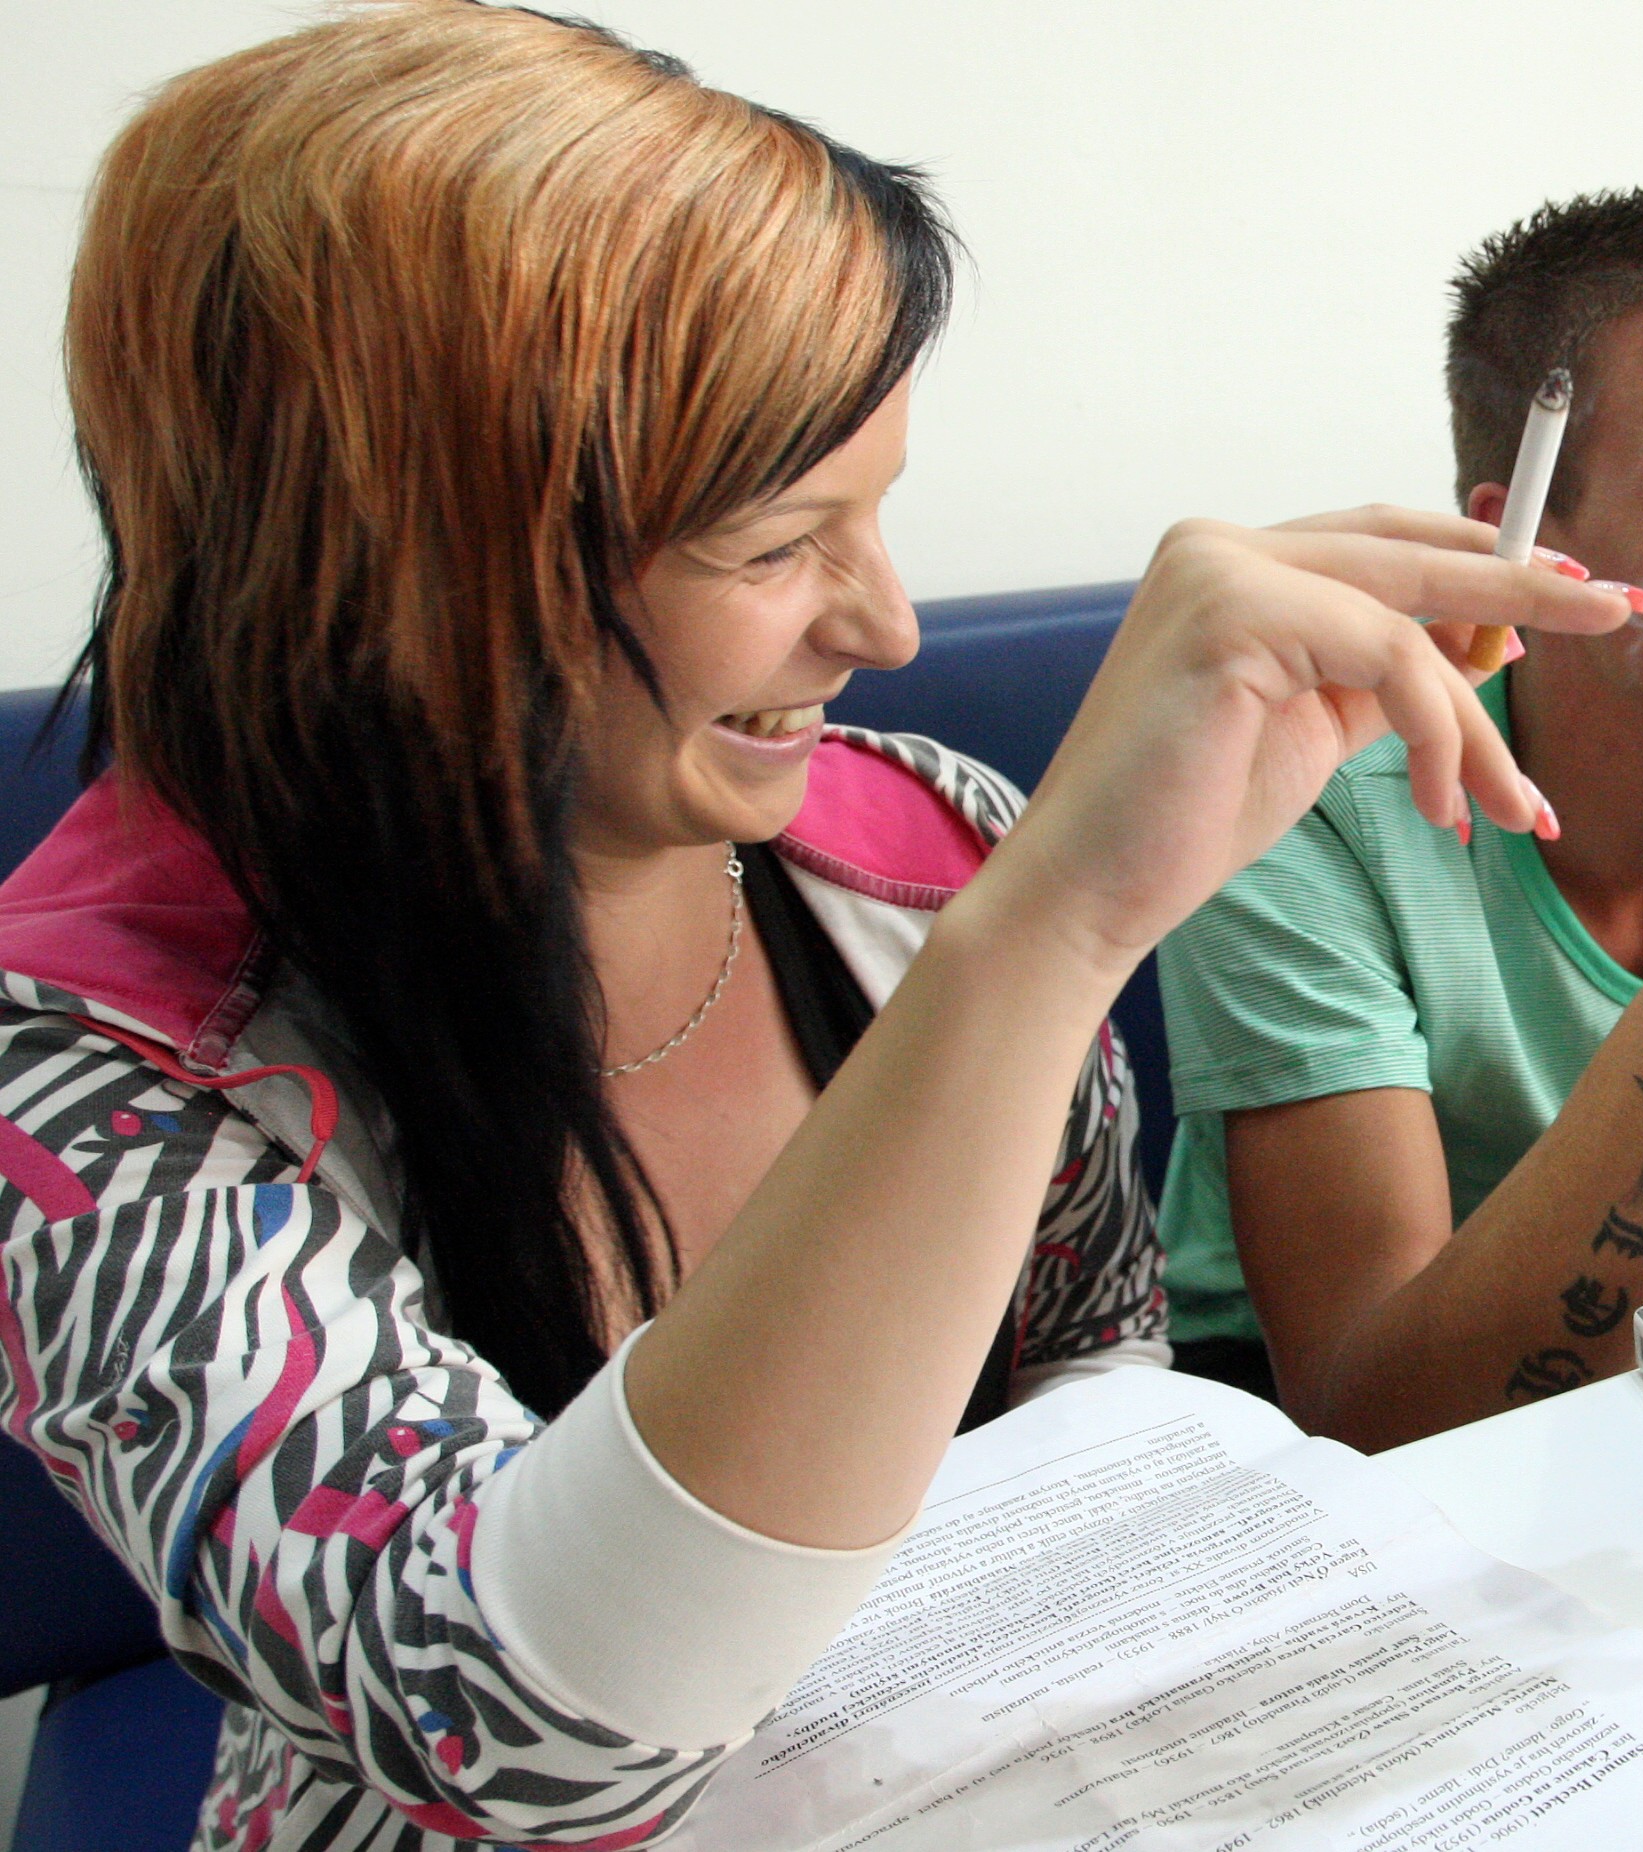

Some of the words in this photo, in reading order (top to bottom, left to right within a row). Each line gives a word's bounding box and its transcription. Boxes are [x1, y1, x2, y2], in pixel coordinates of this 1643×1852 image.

[1266, 1536, 1310, 1560] Smútok
[1290, 1543, 1322, 1559] Cesta
[1339, 1539, 1359, 1549] hra
[1294, 1552, 1332, 1571] Veľký
[1329, 1548, 1368, 1567] Eugen
[1218, 1558, 1264, 1581] pristane
[1250, 1559, 1288, 1580] dlhého
[1268, 1571, 1292, 1583] boh
[1347, 1562, 1377, 1578] USA
[1175, 1579, 1219, 1598] Elektre
[1209, 1589, 1224, 1597] do
[1223, 1584, 1266, 1604] Brown
[1225, 1580, 1247, 1590] dňa
[1180, 1595, 1206, 1607] noci
[1340, 1595, 1370, 1610] Dom
[1387, 1592, 1407, 1603] hry
[1108, 1601, 1160, 1626] moderná
[1171, 1606, 1210, 1623] dráma
[1285, 1609, 1338, 1634] Bernardy
[1331, 1606, 1378, 1628] Krvavá
[1364, 1601, 1417, 1624] Federico
[1364, 1607, 1428, 1636] Španielsko
[1067, 1625, 1106, 1642] verzia
[1168, 1623, 1199, 1639] 1888
[1285, 1626, 1329, 1645] svadba
[1318, 1624, 1362, 1644] García
[1426, 1622, 1446, 1632] hra
[1043, 1614, 1157, 1667] autobiografickými
[1105, 1626, 1160, 1651] maskami
[1247, 1632, 1280, 1646] Alby,
[1392, 1634, 1420, 1650] Šesť
[1423, 1630, 1457, 1647] Luigi
[1003, 1641, 1064, 1671] antického
[1117, 1642, 1154, 1660] 1953)
[1278, 1644, 1316, 1660] Lorca
[1349, 1647, 1388, 1669] postáv
[1357, 1646, 1422, 1676] Pirandello
[1411, 1637, 1470, 1663] Taliansko
[1000, 1664, 1040, 1685] črtami
[1051, 1662, 1104, 1686] realista,
[1137, 1647, 1272, 1712] poeticko-dramatická
[1216, 1658, 1276, 1686] (Federiko
[1306, 1668, 1345, 1688] hľadá
[1432, 1660, 1467, 1678] Svätá
[1468, 1663, 1512, 1684] George
[950, 1669, 999, 1696] príbehu
[1312, 1676, 1356, 1697] (Lujdži
[1397, 1677, 1430, 1692] Jana,
[1408, 1668, 1476, 1701] Pygmalion
[1469, 1668, 1521, 1694] Anglicko
[1504, 1677, 1557, 1705] Maurice
[982, 1687, 1050, 1722] naturalista
[1172, 1686, 1214, 1705] Garsía
[1260, 1685, 1304, 1706] autora
[1352, 1696, 1394, 1717] Caesar
[1410, 1685, 1465, 1712] Bernard
[1516, 1683, 1570, 1713] Belgicko
[1110, 1710, 1135, 1723] hra
[1126, 1704, 1170, 1729] Lorka)
[1243, 1696, 1310, 1728] Pirandelo)
[1374, 1712, 1409, 1729] Shaw
[1550, 1708, 1584, 1732] Gogo:
[787, 1712, 838, 1737] hudby,
[1189, 1710, 1247, 1738] hľadanie
[1276, 1720, 1340, 1750] Kleopatra
[1298, 1701, 1406, 1752] (spopularizovaná
[1421, 1706, 1502, 1747] Maeterlinck
[1550, 1717, 1598, 1749] zároveň
[761, 1719, 848, 1766] divadelného
[1057, 1722, 1107, 1750] (neskôr
[1090, 1729, 1122, 1744] 1898
[1211, 1728, 1241, 1744] 1867
[1500, 1732, 1546, 1761] Ideme?
[1552, 1723, 1620, 1766] neznámeho
[1014, 1741, 1052, 1763] podľa
[1041, 1746, 1074, 1762] 1936
[1121, 1738, 1187, 1765] totožnosti
[1154, 1748, 1194, 1766] 1936)
[1279, 1748, 1332, 1774] Bernard
[1376, 1746, 1420, 1771] (Móris
[1514, 1756, 1527, 1769] je
[1528, 1747, 1552, 1760] hra
[1256, 1752, 1298, 1774] neskôr
[1468, 1757, 1499, 1776] Didi
[1554, 1750, 1610, 1783] Čakanie
[1054, 1768, 1138, 1807] relativizmus
[1227, 1773, 1251, 1785] ako
[1244, 1774, 1279, 1790] Šou)
[1302, 1770, 1376, 1810] Meterlink)
[1503, 1766, 1552, 1793] Godota
[1534, 1783, 1551, 1794] na
[1168, 1785, 1224, 1811] muzikál
[1208, 1790, 1242, 1806] 1856
[1418, 1778, 1460, 1804] Ideme
[1437, 1769, 1512, 1813] vystihnutím
[1530, 1779, 1592, 1817] Beckett
[918, 1794, 952, 1814] balet
[1142, 1808, 1165, 1819] My
[1450, 1800, 1492, 1826] Godot
[1482, 1796, 1533, 1824] Godota
[1112, 1818, 1137, 1831] fair
[1157, 1811, 1192, 1826] 1950
[1267, 1808, 1300, 1828] 1862
[1360, 1807, 1408, 1836] (sedia)
[1490, 1815, 1529, 1840] (1906
[1411, 1823, 1448, 1847] nikdy
[1434, 1824, 1481, 1852] (1952)
